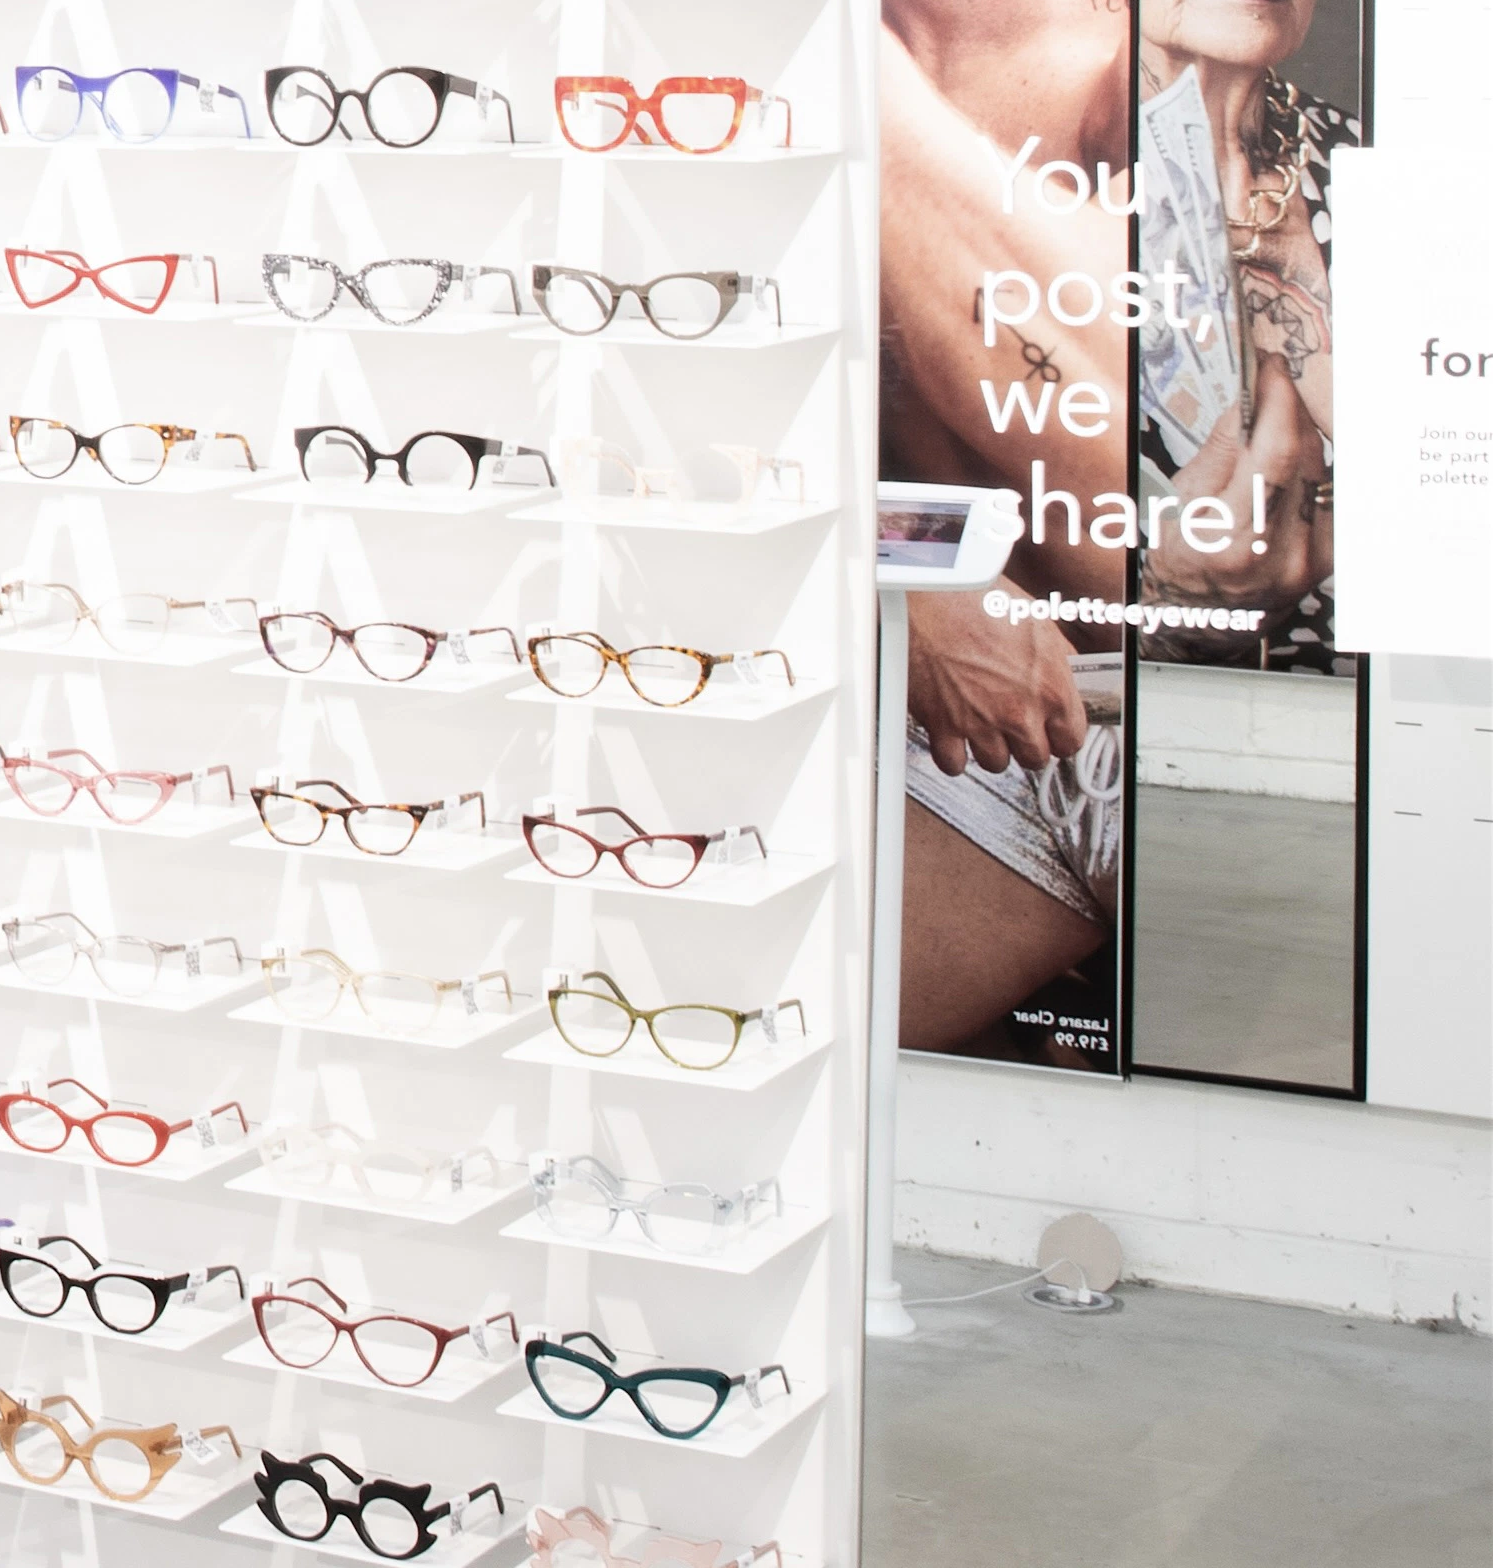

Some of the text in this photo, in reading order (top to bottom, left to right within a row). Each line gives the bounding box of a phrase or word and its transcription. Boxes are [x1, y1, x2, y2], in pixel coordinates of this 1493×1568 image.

[981, 135, 1149, 217] You
[982, 258, 1213, 348] post,
[979, 378, 1112, 438] we
[1420, 425, 1458, 440] Join
[1420, 447, 1489, 466] be part
[1420, 470, 1489, 486] polette
[983, 460, 1269, 556] share!
[983, 590, 1265, 633] @poletteeyewear
